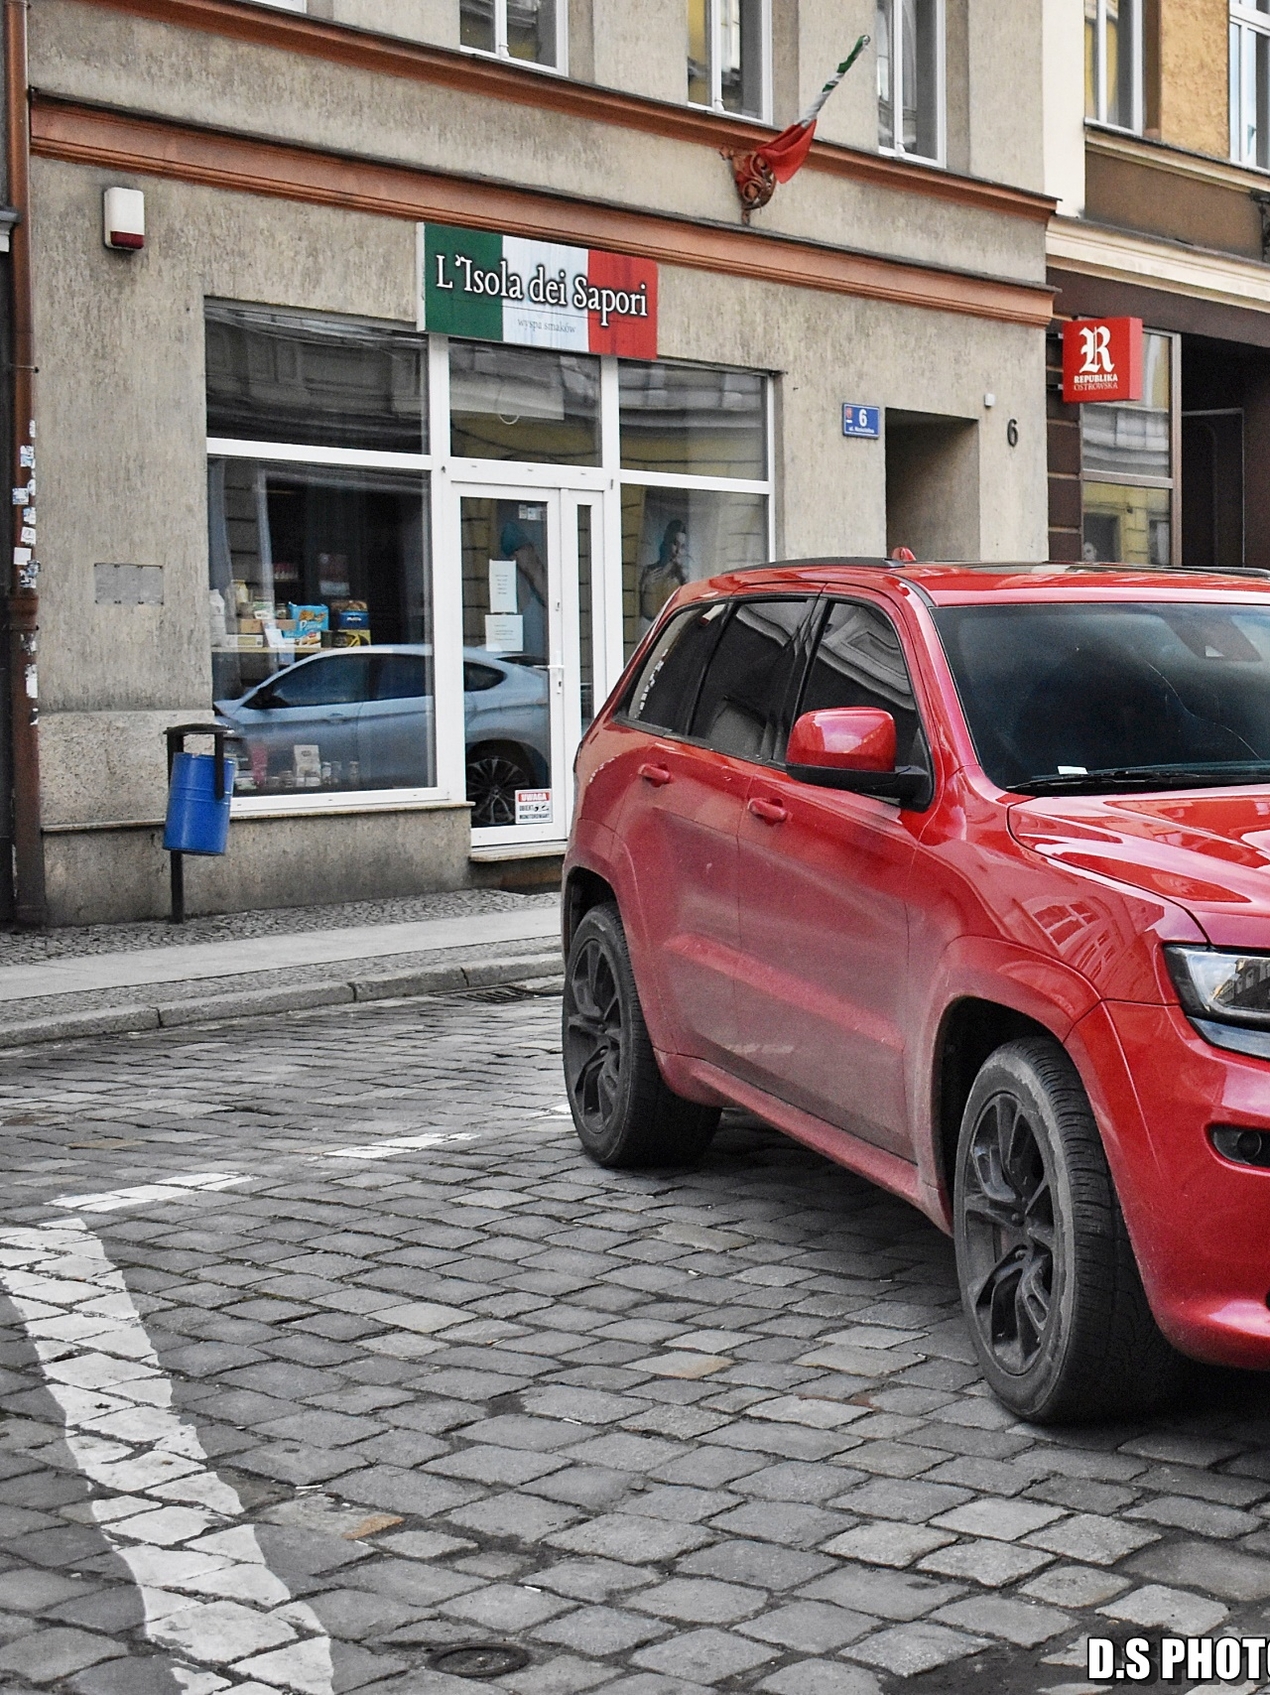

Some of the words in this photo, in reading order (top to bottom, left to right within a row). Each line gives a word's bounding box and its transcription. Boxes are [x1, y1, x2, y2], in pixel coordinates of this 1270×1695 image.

[528, 264, 568, 306] dei
[572, 274, 649, 328] Sapori
[517, 317, 542, 333] wyspa
[544, 321, 577, 334] smaków
[1078, 325, 1116, 374] R
[1073, 373, 1119, 384] REPUBLIKA
[1073, 382, 1119, 391] OSTROWSKA
[858, 408, 868, 427] 6
[1006, 418, 1019, 448] 6
[521, 793, 548, 802] UWAGA
